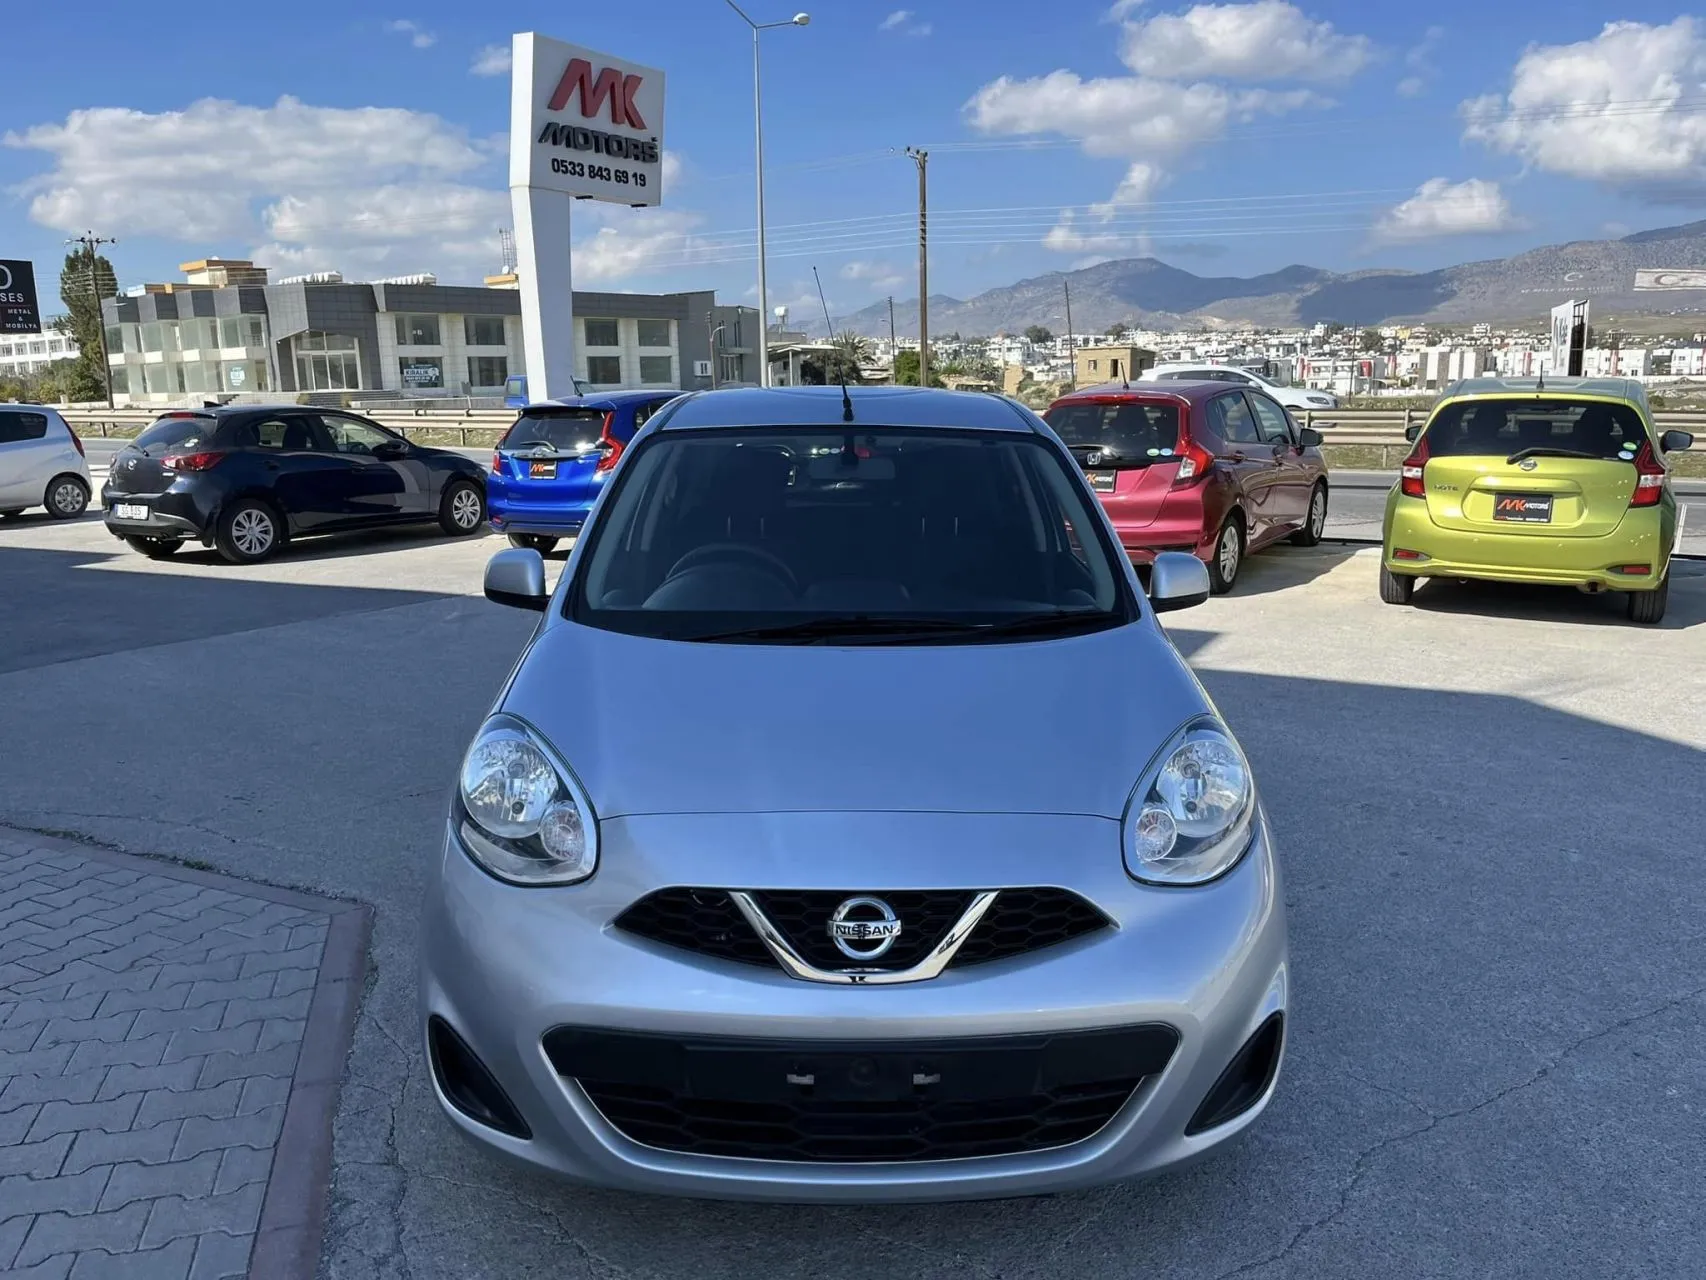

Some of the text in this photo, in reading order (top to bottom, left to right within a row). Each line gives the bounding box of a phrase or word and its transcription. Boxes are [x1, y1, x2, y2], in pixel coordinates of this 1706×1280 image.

[547, 58, 647, 130] MK
[538, 122, 658, 163] MOTORS
[552, 158, 647, 187] 0533 843 69 19
[1497, 498, 1526, 512] MK
[835, 924, 893, 936] NISSAN
